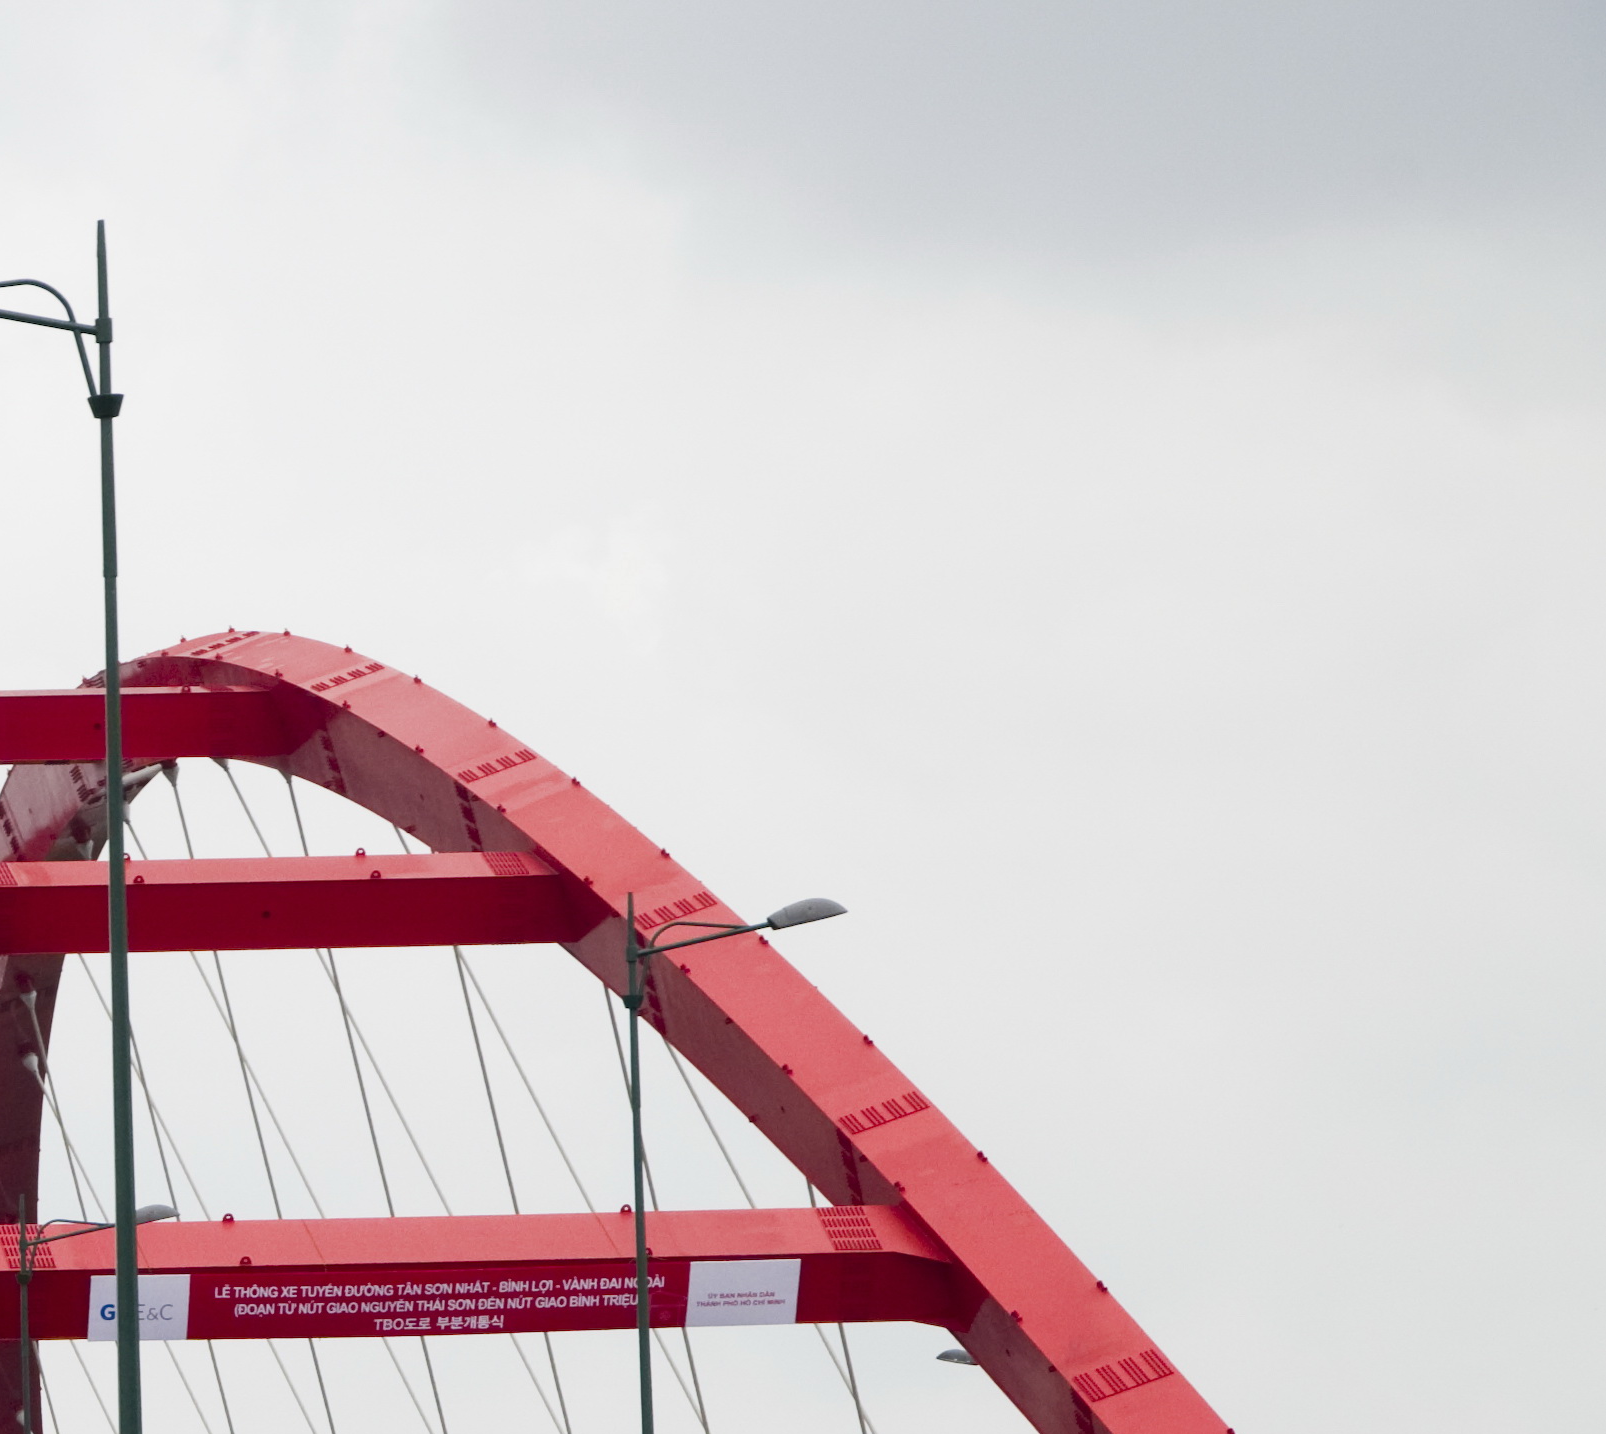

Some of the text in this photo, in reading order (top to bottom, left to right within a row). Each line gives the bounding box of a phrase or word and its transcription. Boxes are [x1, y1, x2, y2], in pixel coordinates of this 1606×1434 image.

[233, 1283, 279, 1298] THÔNG
[280, 1286, 298, 1298] XE
[300, 1282, 343, 1298] TUYẾN
[344, 1282, 394, 1298] ĐƯỜNG
[396, 1281, 423, 1296] TÂN
[424, 1282, 453, 1295] SƠN
[498, 1278, 529, 1293] BÌNH
[531, 1279, 554, 1294] LỢI
[562, 1276, 598, 1290] VÀNH
[599, 1278, 622, 1290] ĐAI
[234, 1303, 275, 1318] (ĐOẠN
[298, 1300, 324, 1314] NÚT
[326, 1301, 359, 1314] GIAO
[361, 1298, 414, 1313] NGUYỄN
[416, 1297, 445, 1312] THÁI
[447, 1298, 475, 1311] SƠN
[477, 1296, 505, 1310] ĐẾN
[507, 1295, 533, 1309] NÚT
[535, 1295, 567, 1308] GIAO
[569, 1292, 599, 1307] BÌNH
